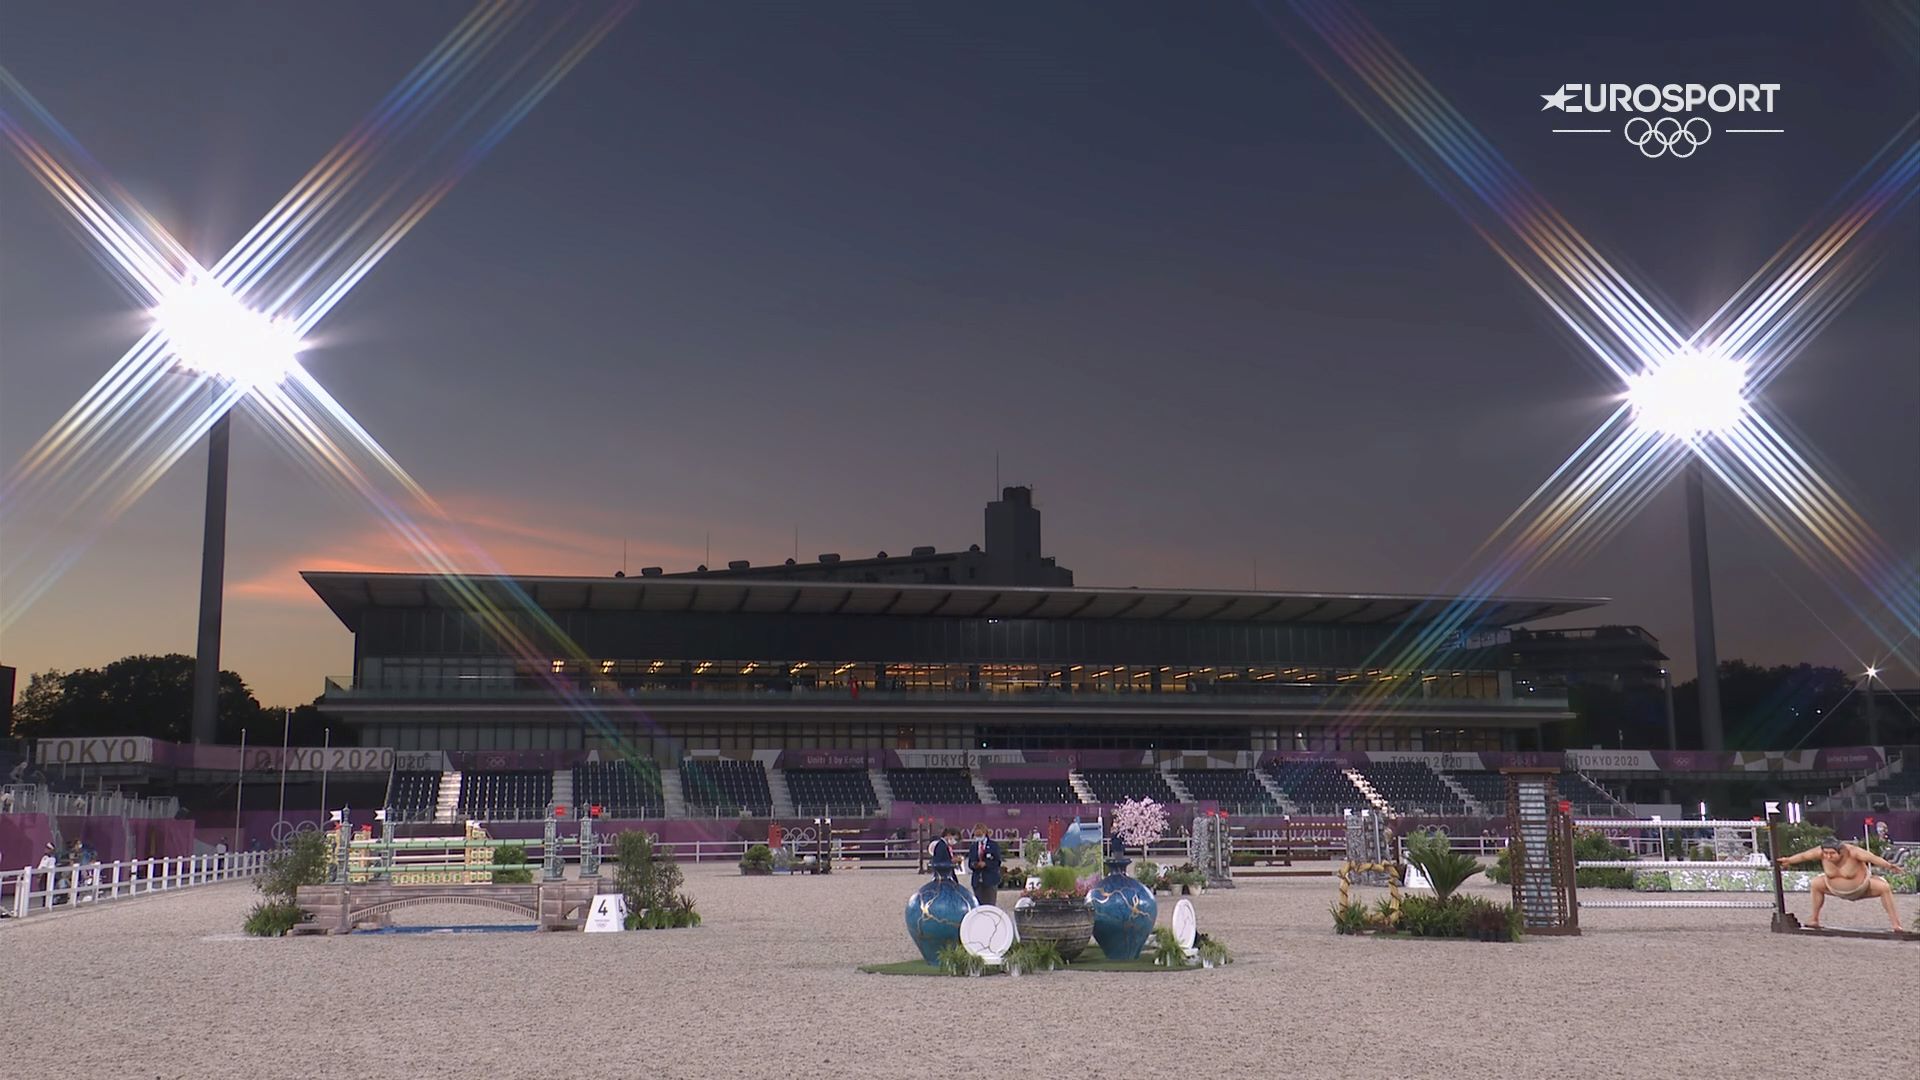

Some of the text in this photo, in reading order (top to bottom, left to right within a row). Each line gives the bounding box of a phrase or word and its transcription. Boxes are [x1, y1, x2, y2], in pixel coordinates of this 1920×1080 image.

[37, 739, 137, 763] TOKYO
[332, 750, 393, 770] 2020
[1578, 755, 1639, 766] TOKYO 2020
[597, 899, 608, 916] 4
